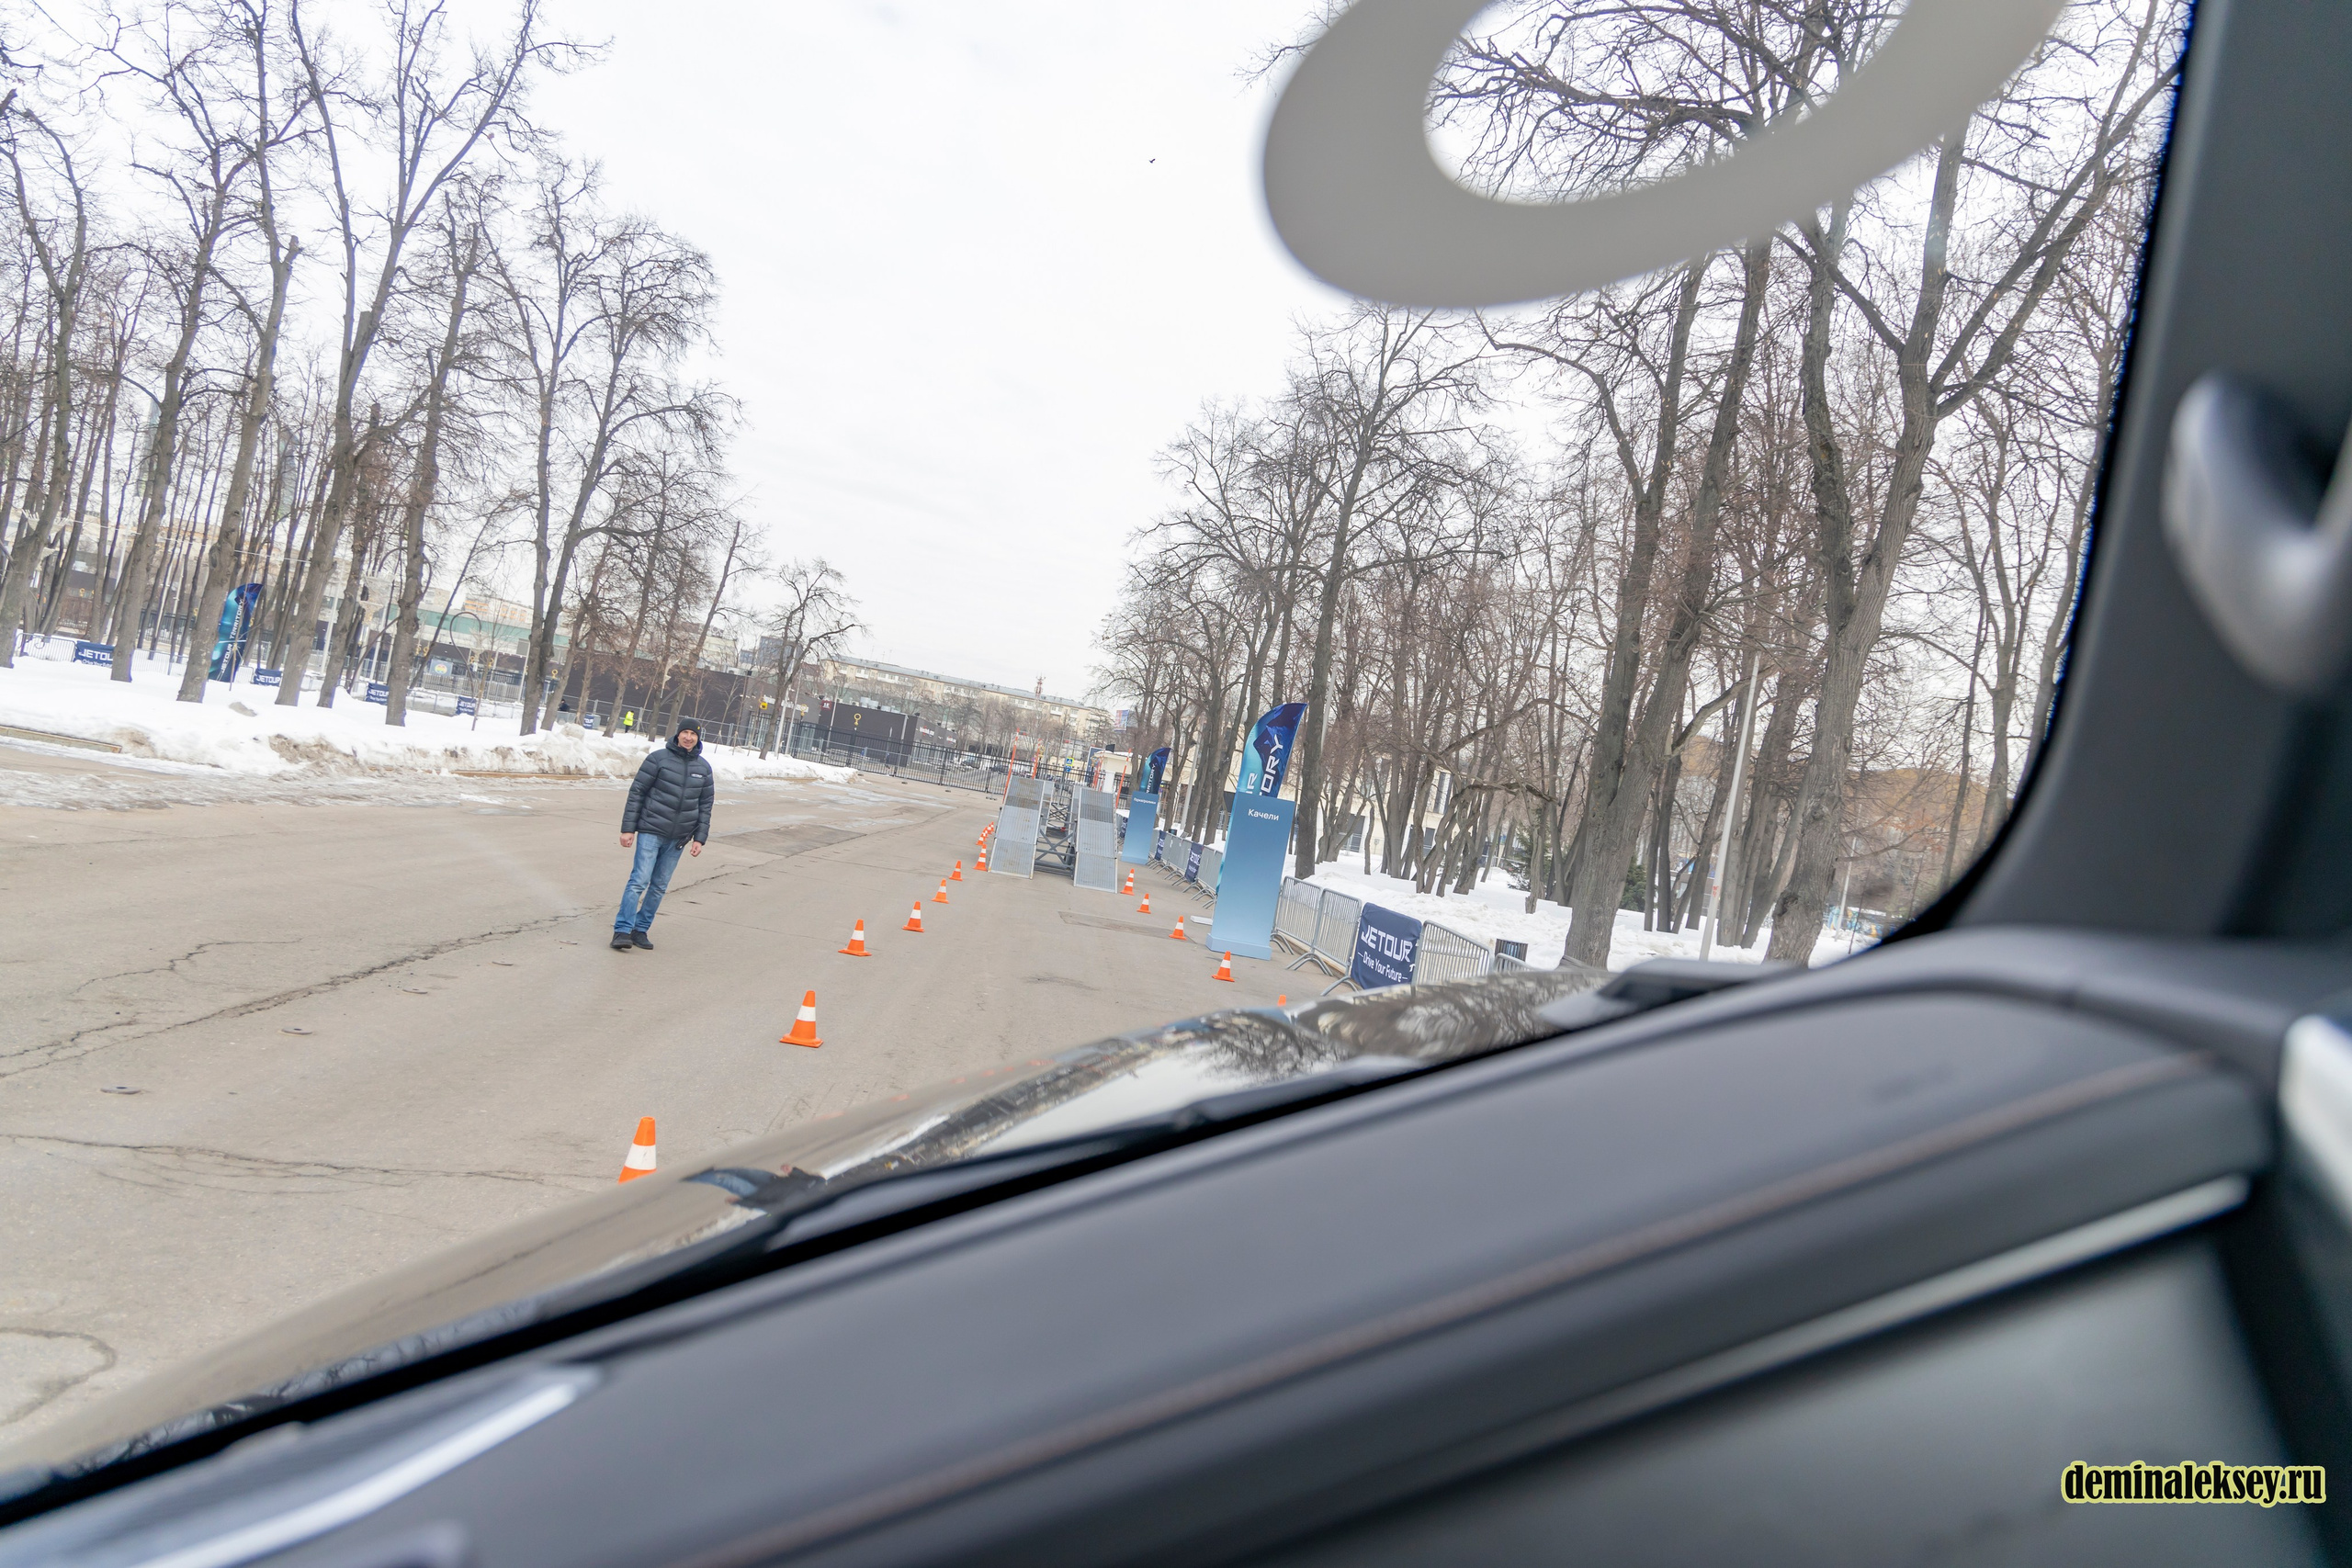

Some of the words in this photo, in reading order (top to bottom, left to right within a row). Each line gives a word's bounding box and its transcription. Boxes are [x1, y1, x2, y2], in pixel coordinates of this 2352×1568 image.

[78, 649, 113, 661] JETOU
[1248, 808, 1279, 820] Качели
[1361, 925, 1413, 962] JETOUR
[1363, 952, 1374, 969] Drive
[1375, 958, 1386, 976] Your
[1385, 964, 1402, 982] Future
